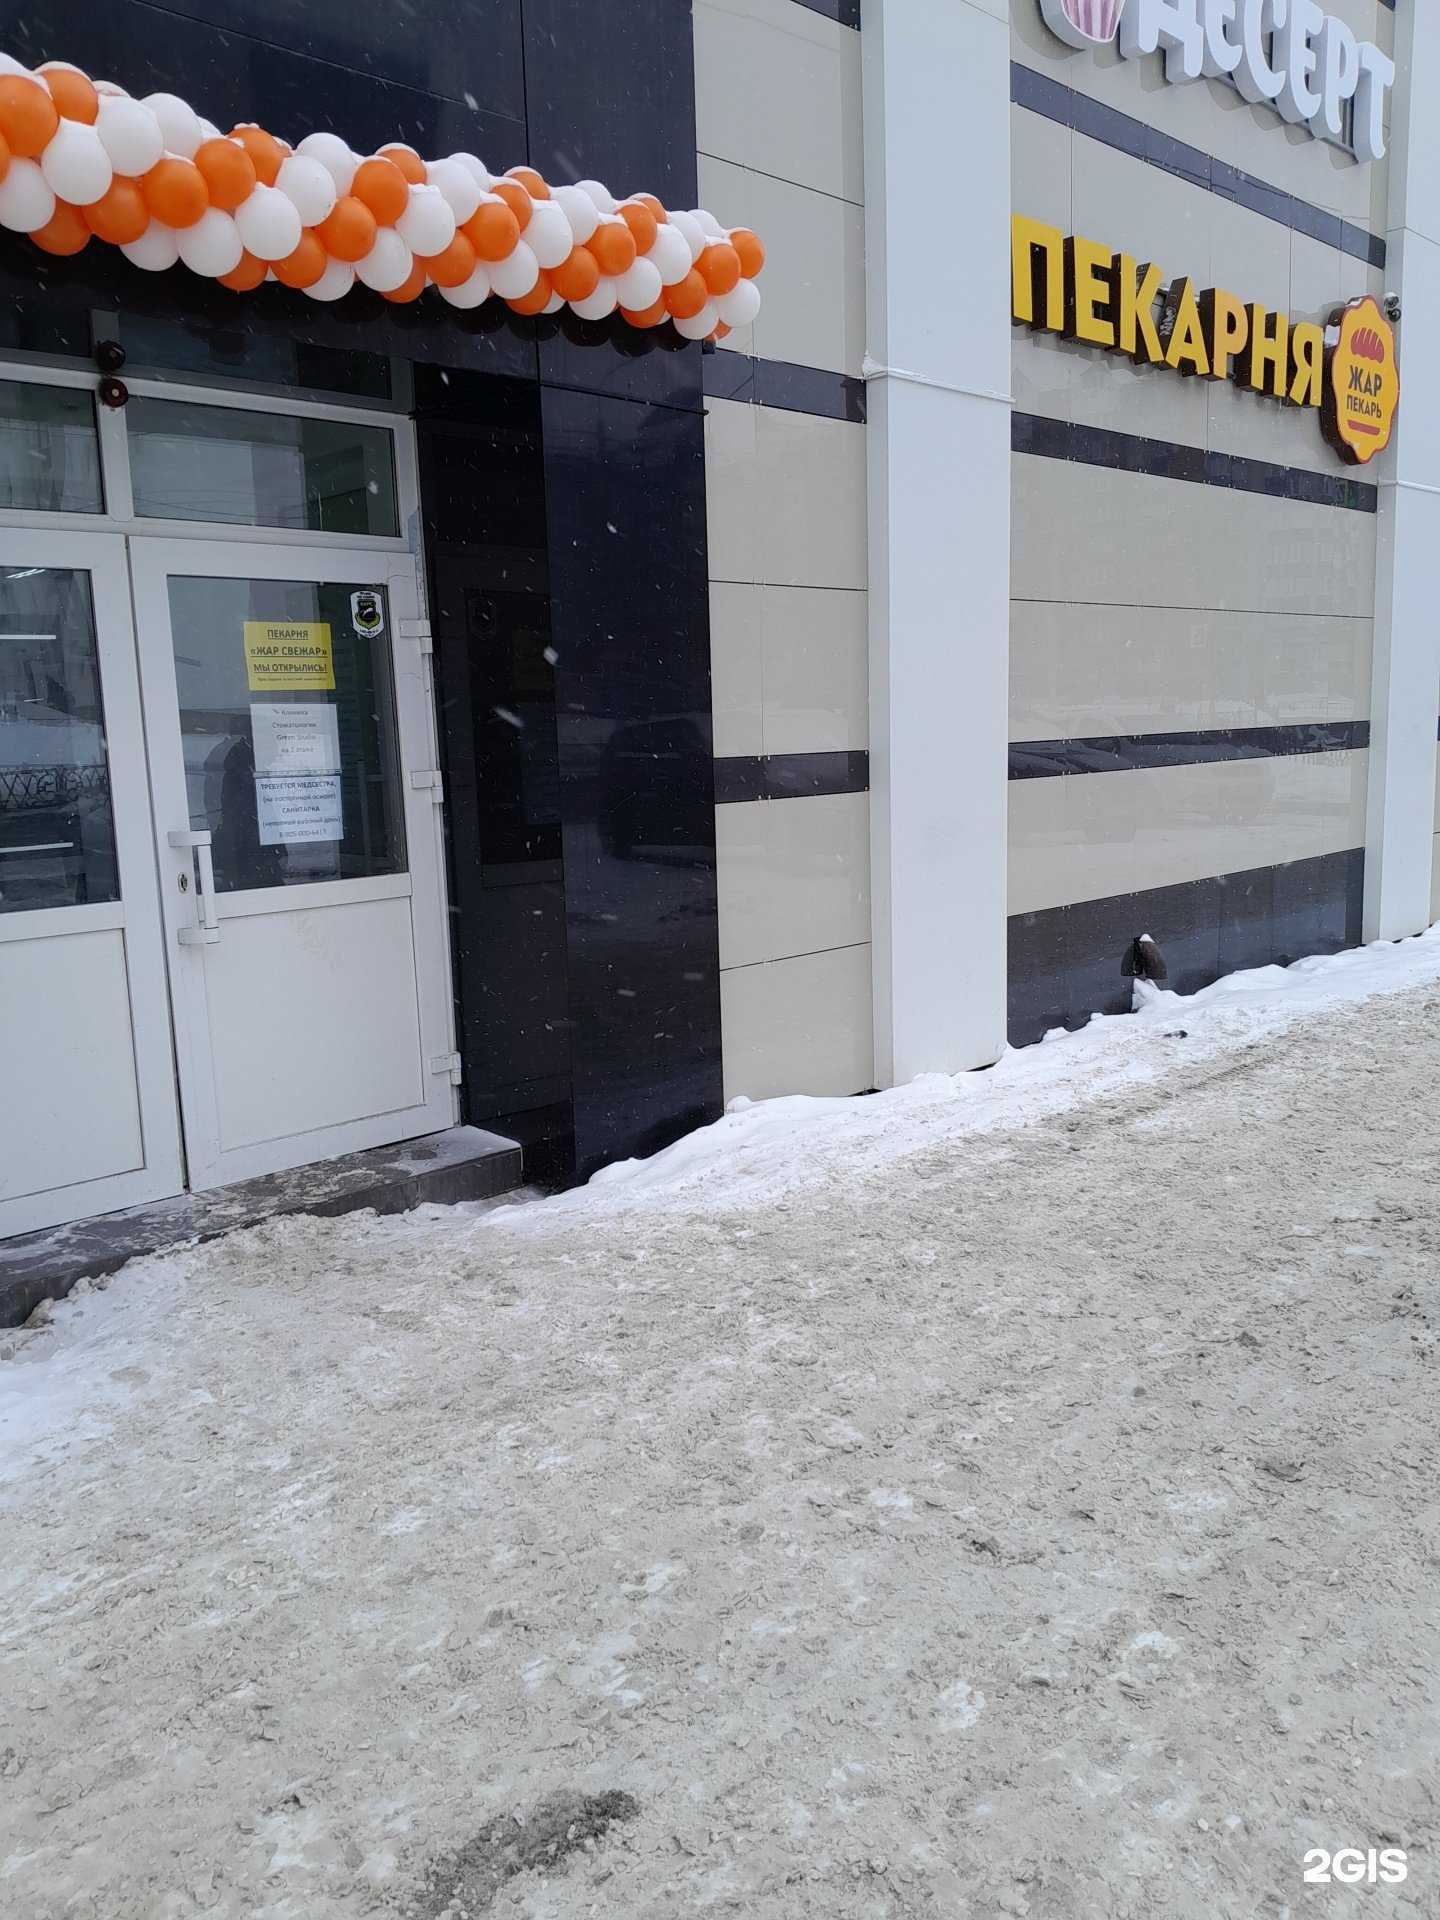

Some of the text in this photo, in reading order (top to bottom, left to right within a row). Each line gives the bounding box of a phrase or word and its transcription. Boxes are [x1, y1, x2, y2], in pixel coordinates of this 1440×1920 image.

[1011, 213, 1323, 407] ПЕКАРНЯ
[1348, 365, 1383, 398] ЖАР
[1346, 395, 1382, 419] ПЕКАРЬ
[267, 629, 309, 640] ПЕКАРНЯ
[250, 646, 328, 657] «ЖАР СВЕЖАР»
[253, 663, 327, 673] МЫ ОТКРЫЛИСЬ!
